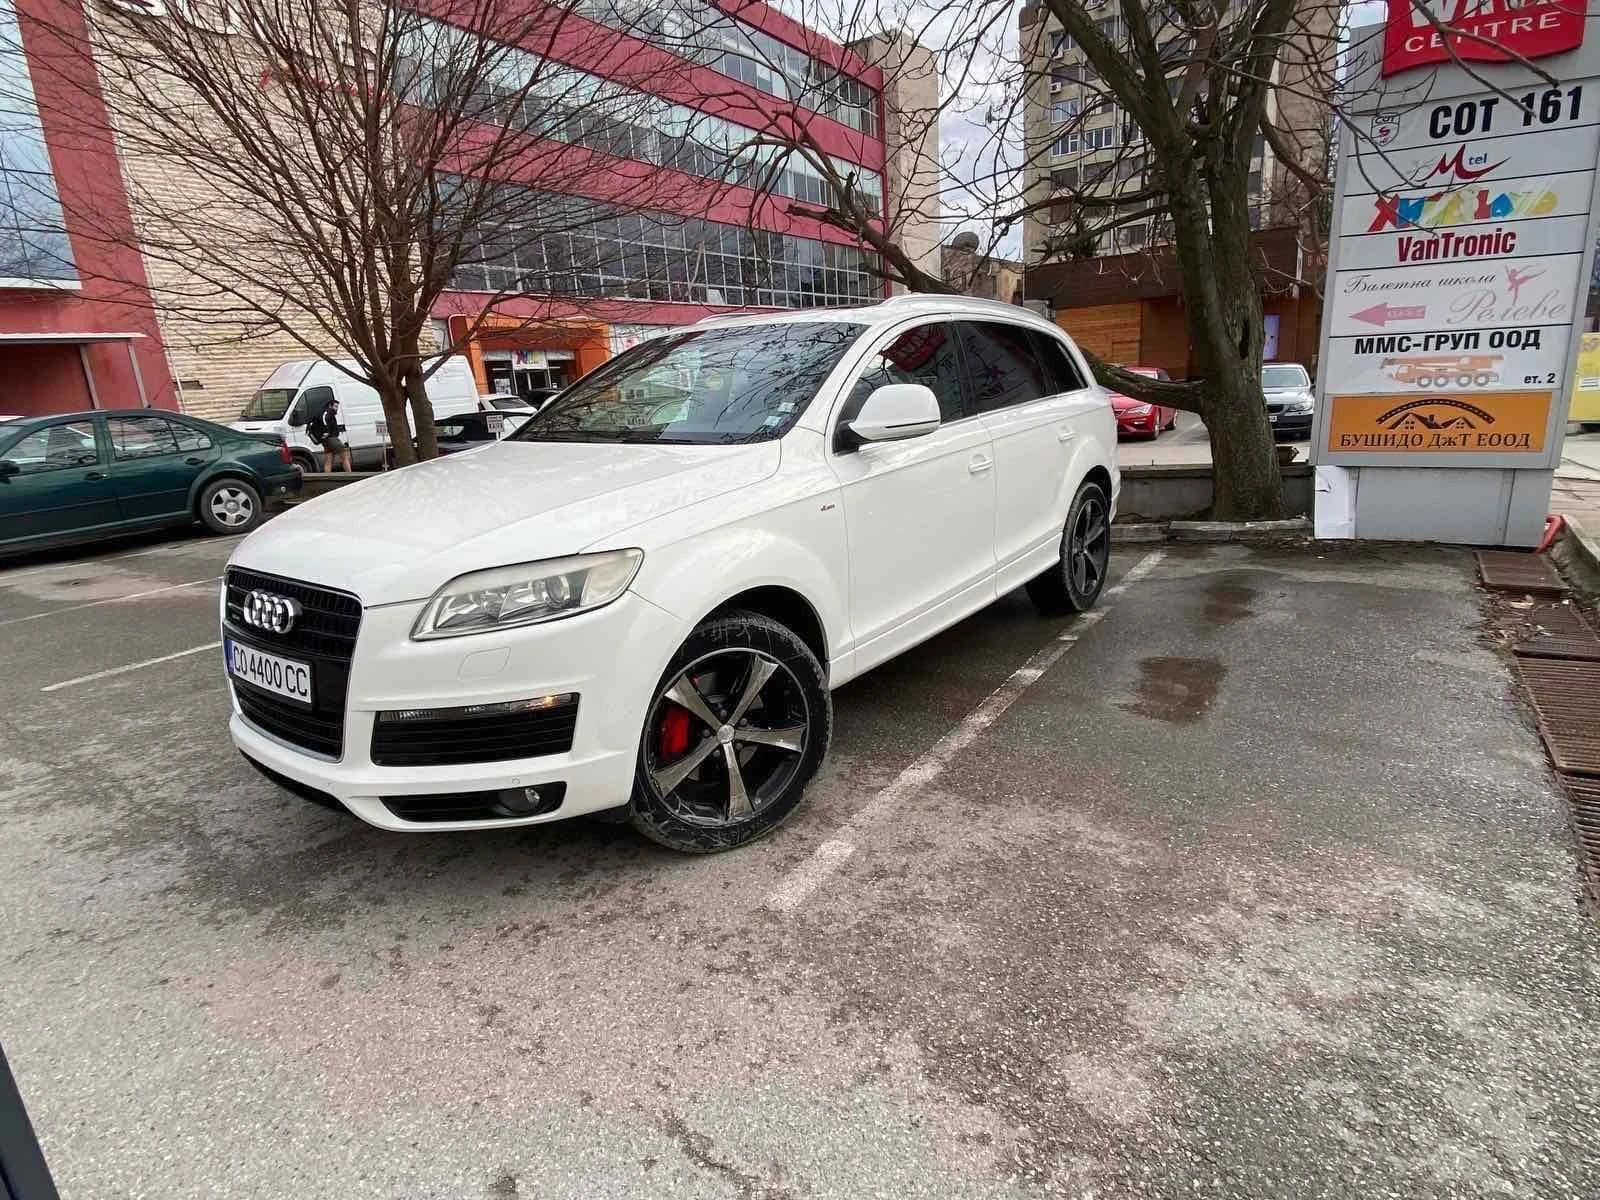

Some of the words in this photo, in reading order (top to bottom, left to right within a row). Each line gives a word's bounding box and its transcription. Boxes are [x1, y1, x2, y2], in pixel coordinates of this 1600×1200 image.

[1409, 0, 1562, 28] WA
[1404, 11, 1561, 52] CENTRE
[1521, 86, 1583, 127] 161
[1397, 228, 1516, 262] VanTronic
[1344, 274, 1432, 295] Балетна
[1438, 273, 1497, 287] школа
[1354, 332, 1480, 354] ММС-ГРУП
[1488, 329, 1541, 351] ООД
[1523, 375, 1542, 384] ет.
[1547, 372, 1556, 384] 2
[1340, 433, 1423, 449] БУШИДО
[1477, 433, 1530, 449] ЕООД
[249, 653, 282, 689] 4400
